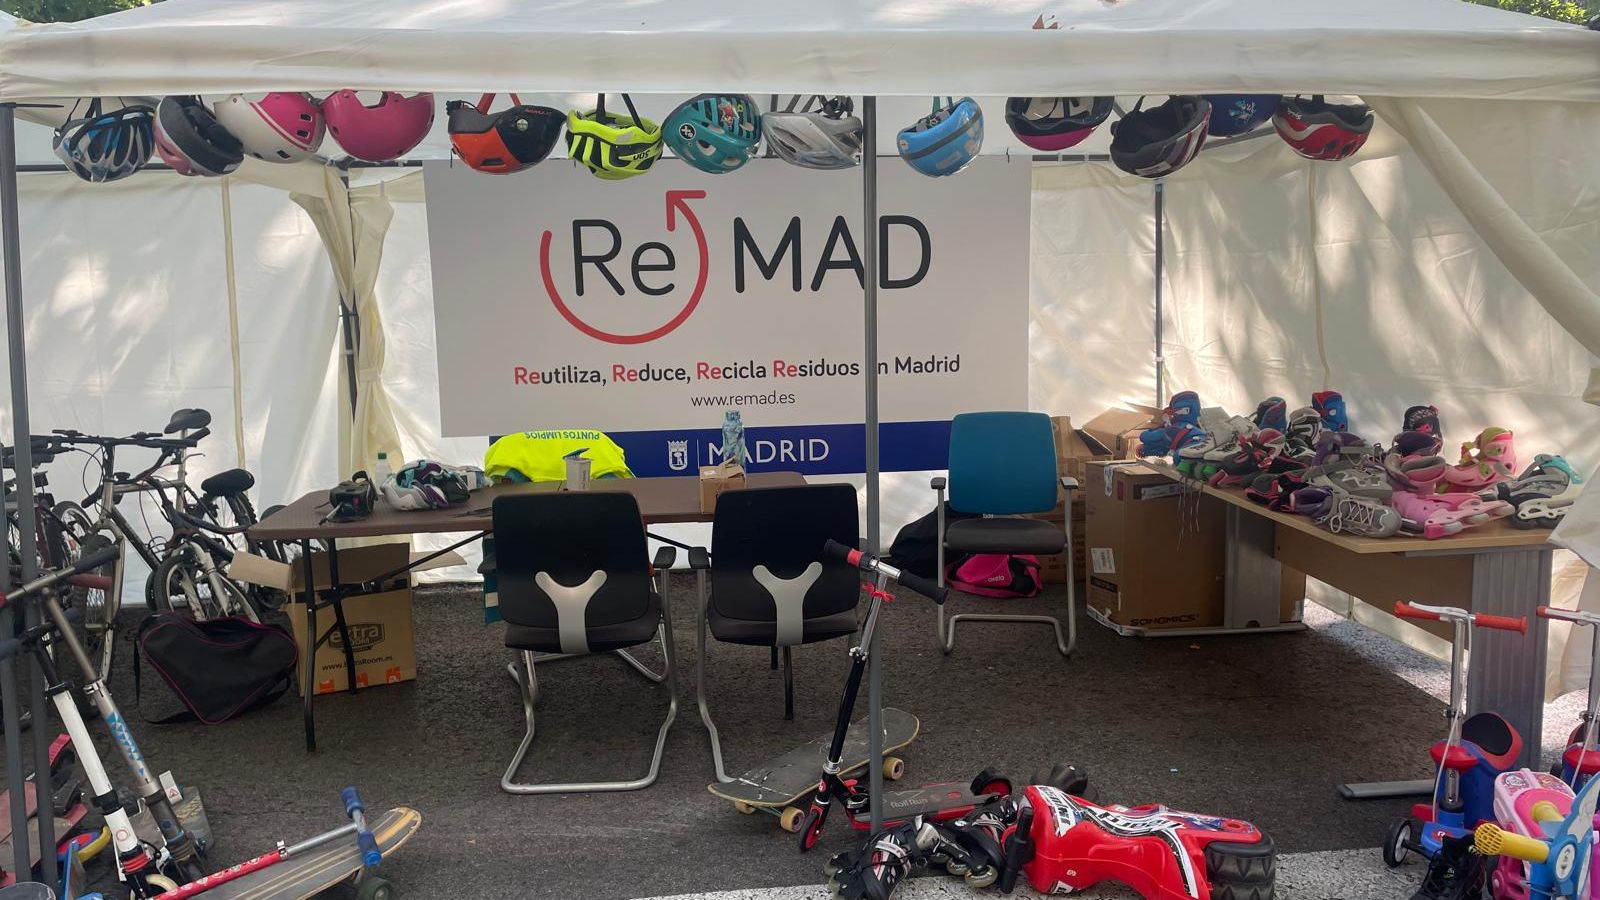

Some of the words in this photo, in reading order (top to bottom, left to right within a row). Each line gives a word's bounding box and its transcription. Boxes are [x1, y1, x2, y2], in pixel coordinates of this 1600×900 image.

[572, 219, 676, 297] Re
[733, 214, 932, 294] MAD
[514, 364, 607, 386] Reutiliza,
[612, 362, 691, 385] Reduce,
[696, 360, 767, 381] Recicla
[773, 358, 860, 378] Residuos
[894, 354, 961, 375] Madrid
[691, 390, 796, 407] www.remad.es
[525, 431, 562, 440] LIMPIOS
[563, 432, 600, 440] PUNTOS
[1129, 613, 1196, 627] SONGMICS
[329, 625, 379, 643] etra
